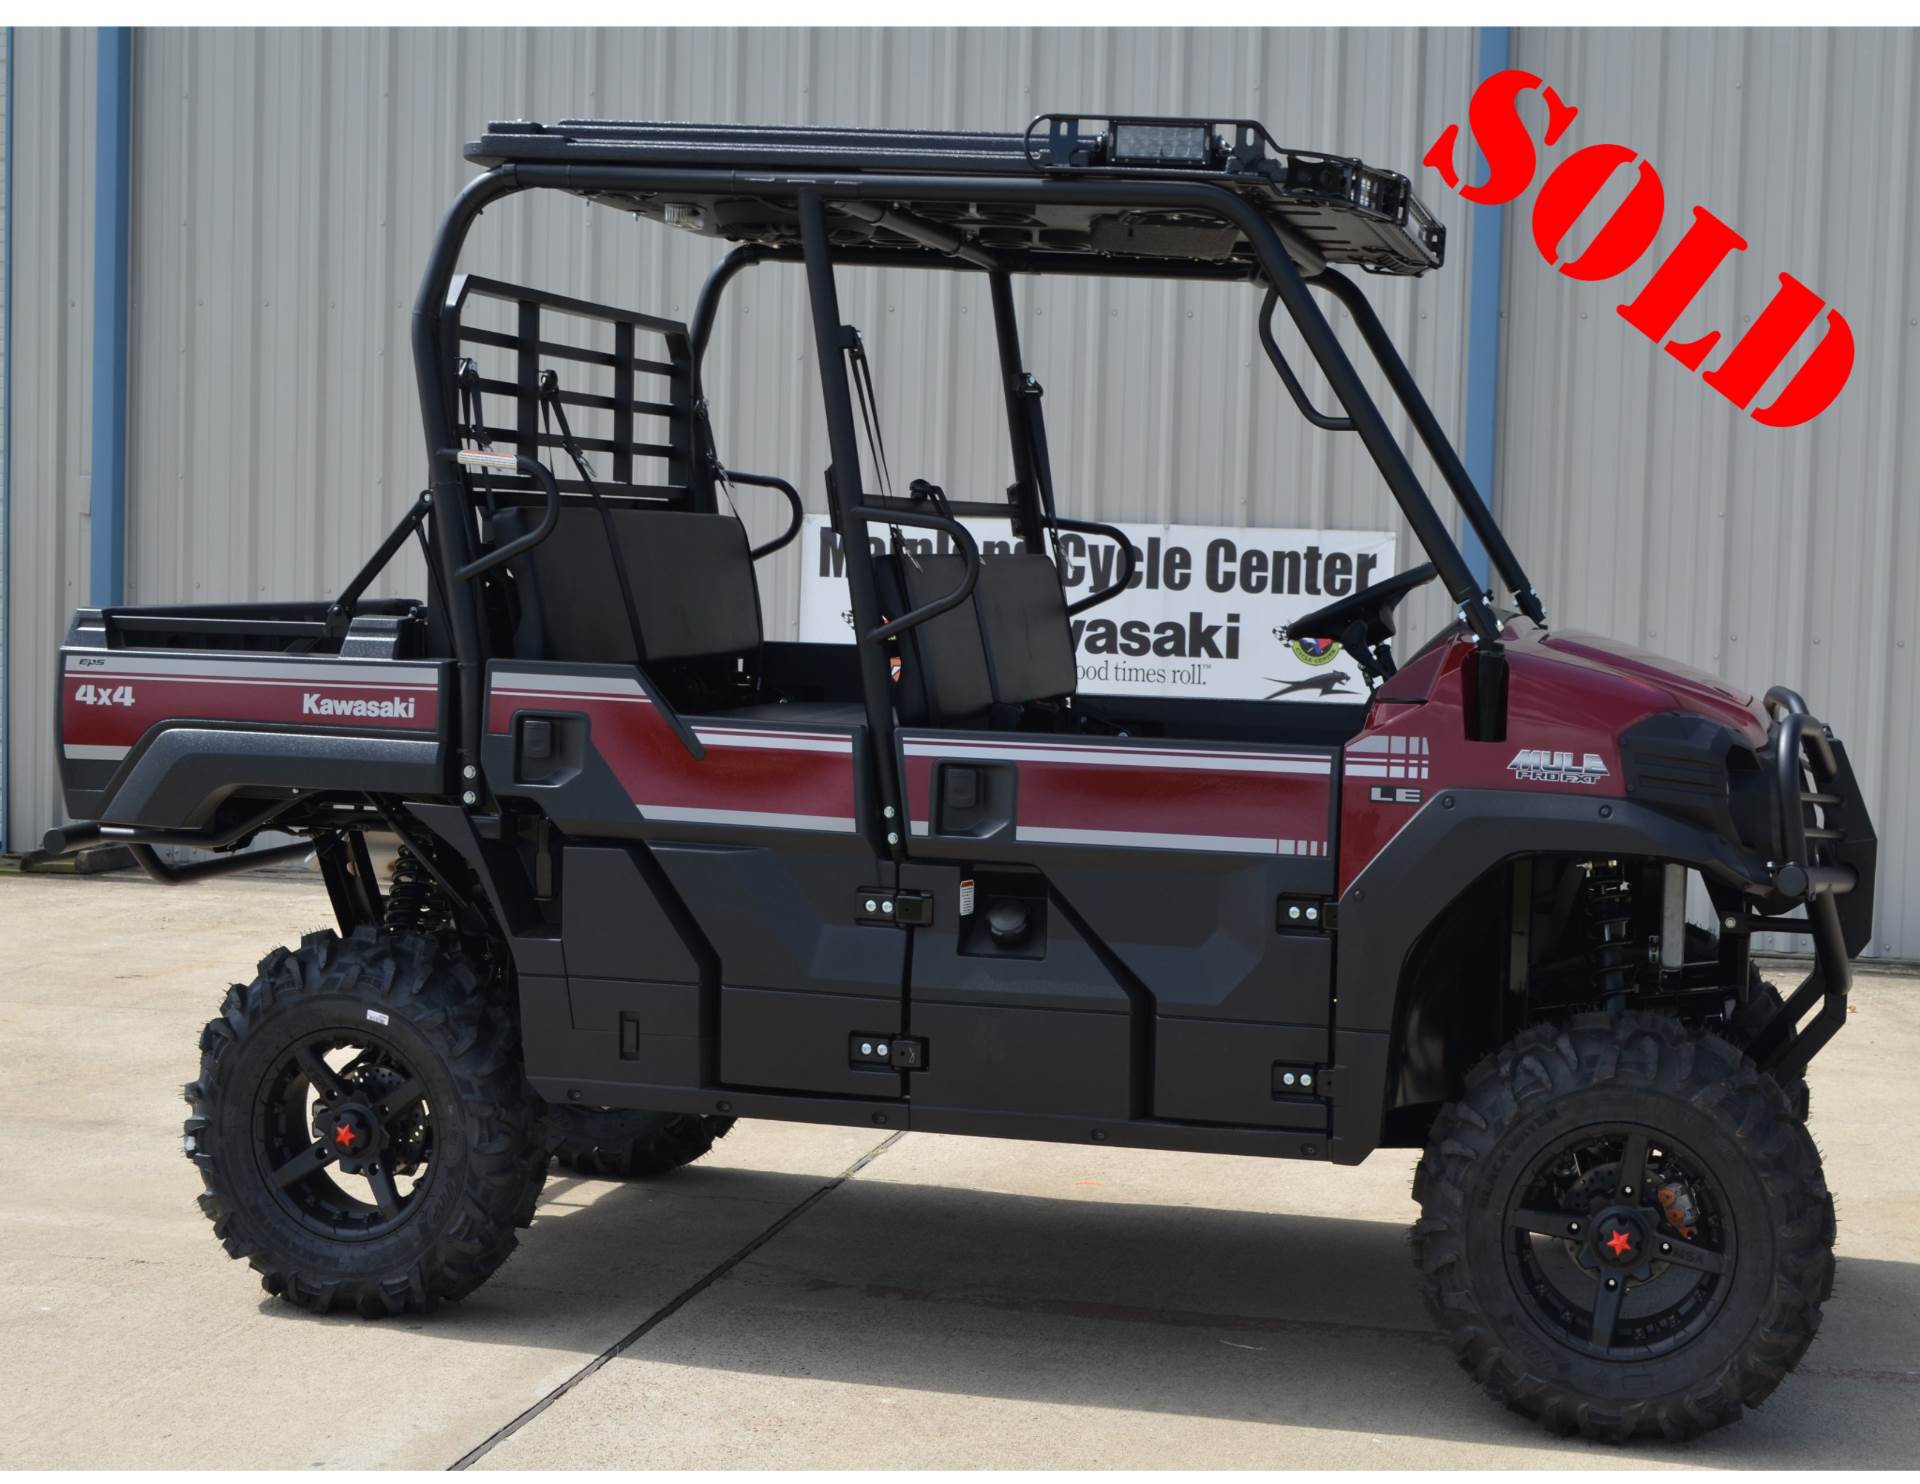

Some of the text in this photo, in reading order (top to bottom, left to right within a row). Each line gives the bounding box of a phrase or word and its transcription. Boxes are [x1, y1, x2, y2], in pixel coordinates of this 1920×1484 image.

[1058, 533, 1192, 594] Cycle
[1206, 538, 1377, 597] Center
[1072, 612, 1240, 660] asaki
[1076, 660, 1109, 681] ood
[1114, 660, 1166, 684] times
[75, 684, 136, 706] 4x4
[303, 693, 415, 719] Kawasaki
[1507, 749, 1610, 776] MULE
[1516, 770, 1600, 784] PRO FXT
[1370, 787, 1421, 802] LE
